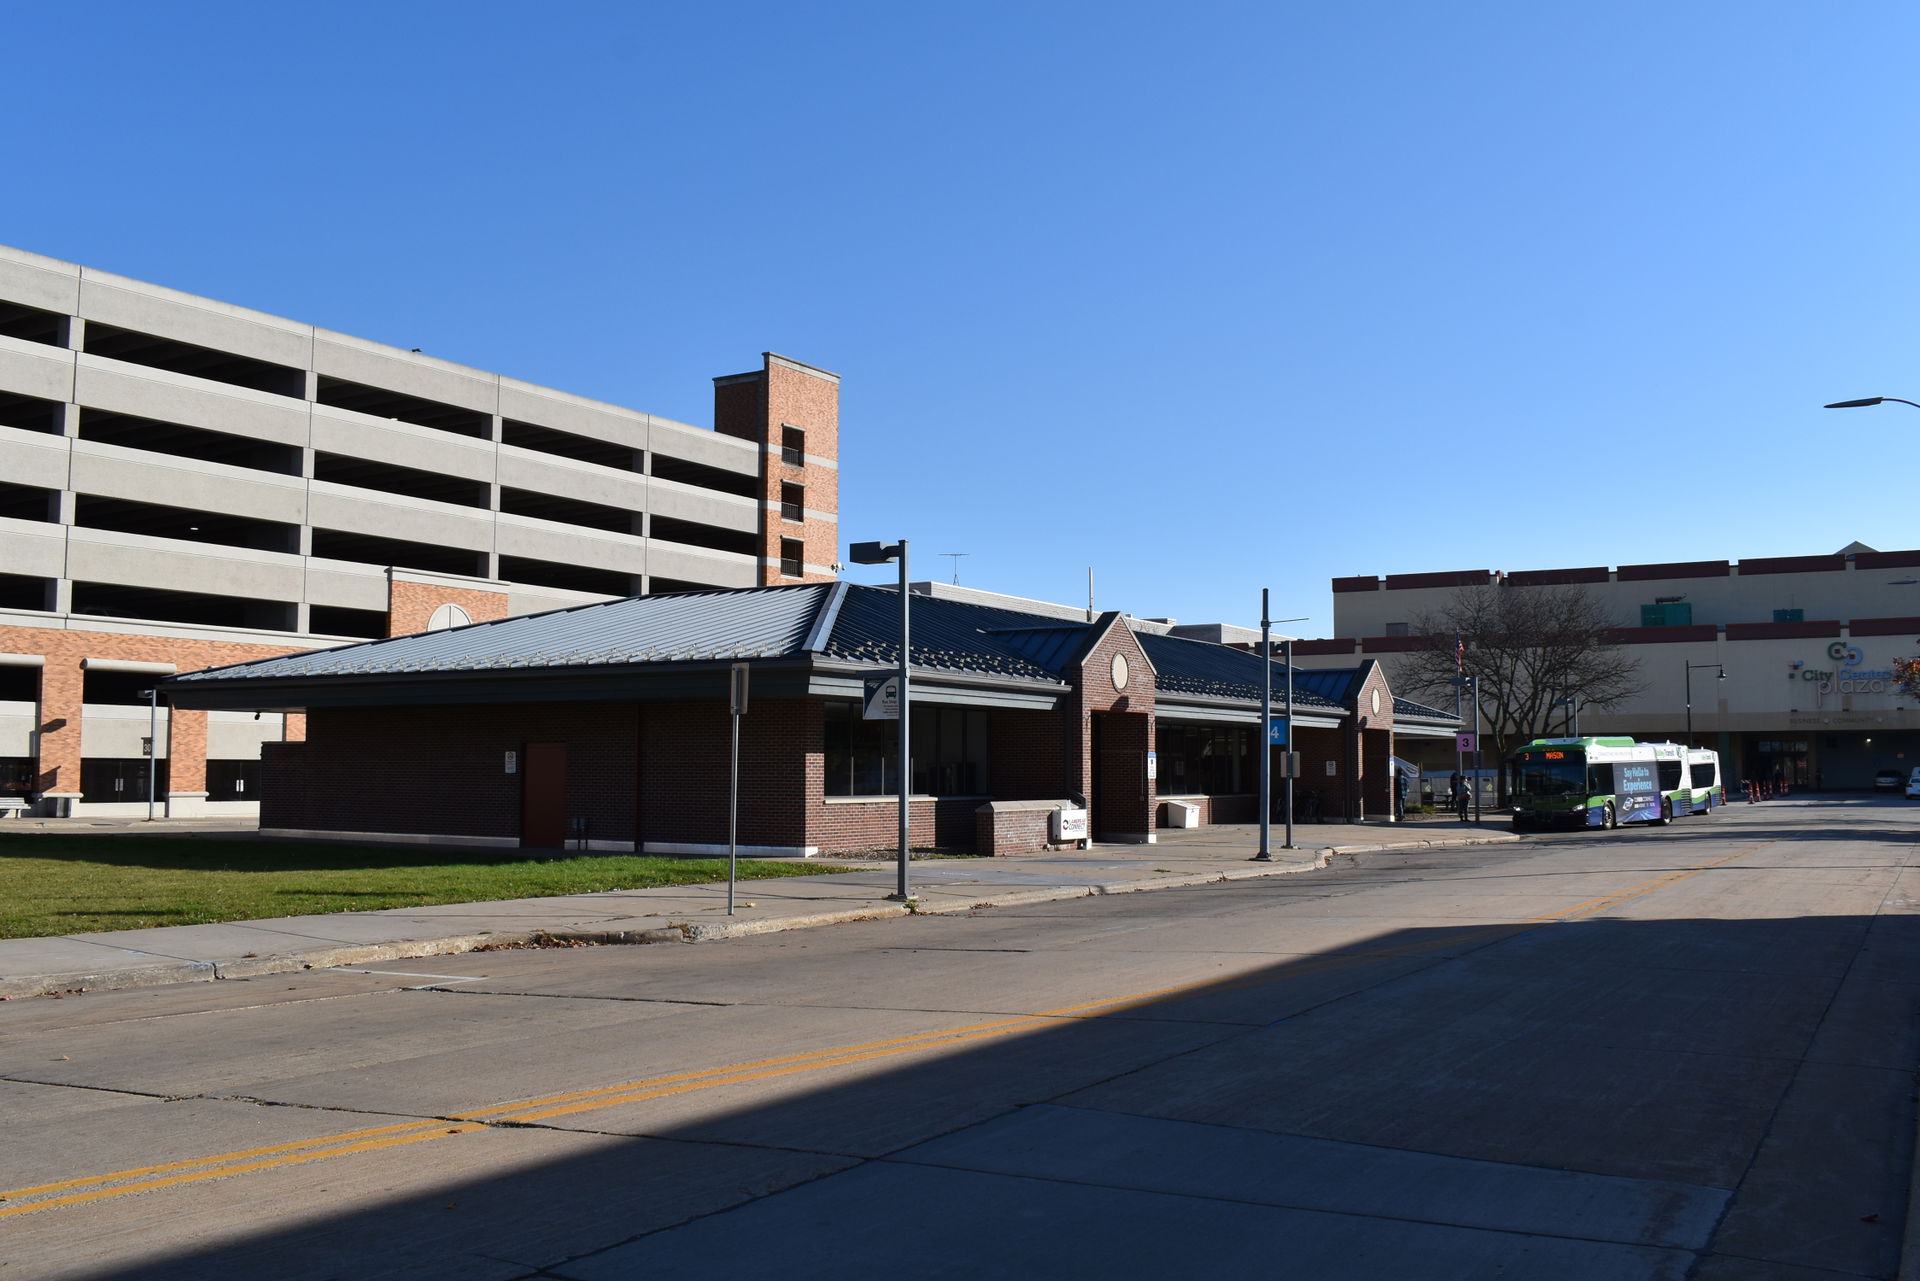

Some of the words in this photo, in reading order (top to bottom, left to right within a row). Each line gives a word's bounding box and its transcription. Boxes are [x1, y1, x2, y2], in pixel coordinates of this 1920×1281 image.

[1802, 670, 1834, 687] City
[1839, 669, 1891, 680] Center
[1816, 664, 1885, 709] plaza
[1270, 726, 1279, 739] 4
[144, 743, 151, 752] 30
[1462, 738, 1469, 748] 3
[1524, 752, 1530, 760] 3
[1545, 751, 1565, 760] MASON
[1624, 767, 1632, 779] Say
[1632, 767, 1644, 777] Hello
[1623, 778, 1653, 795] Experience
